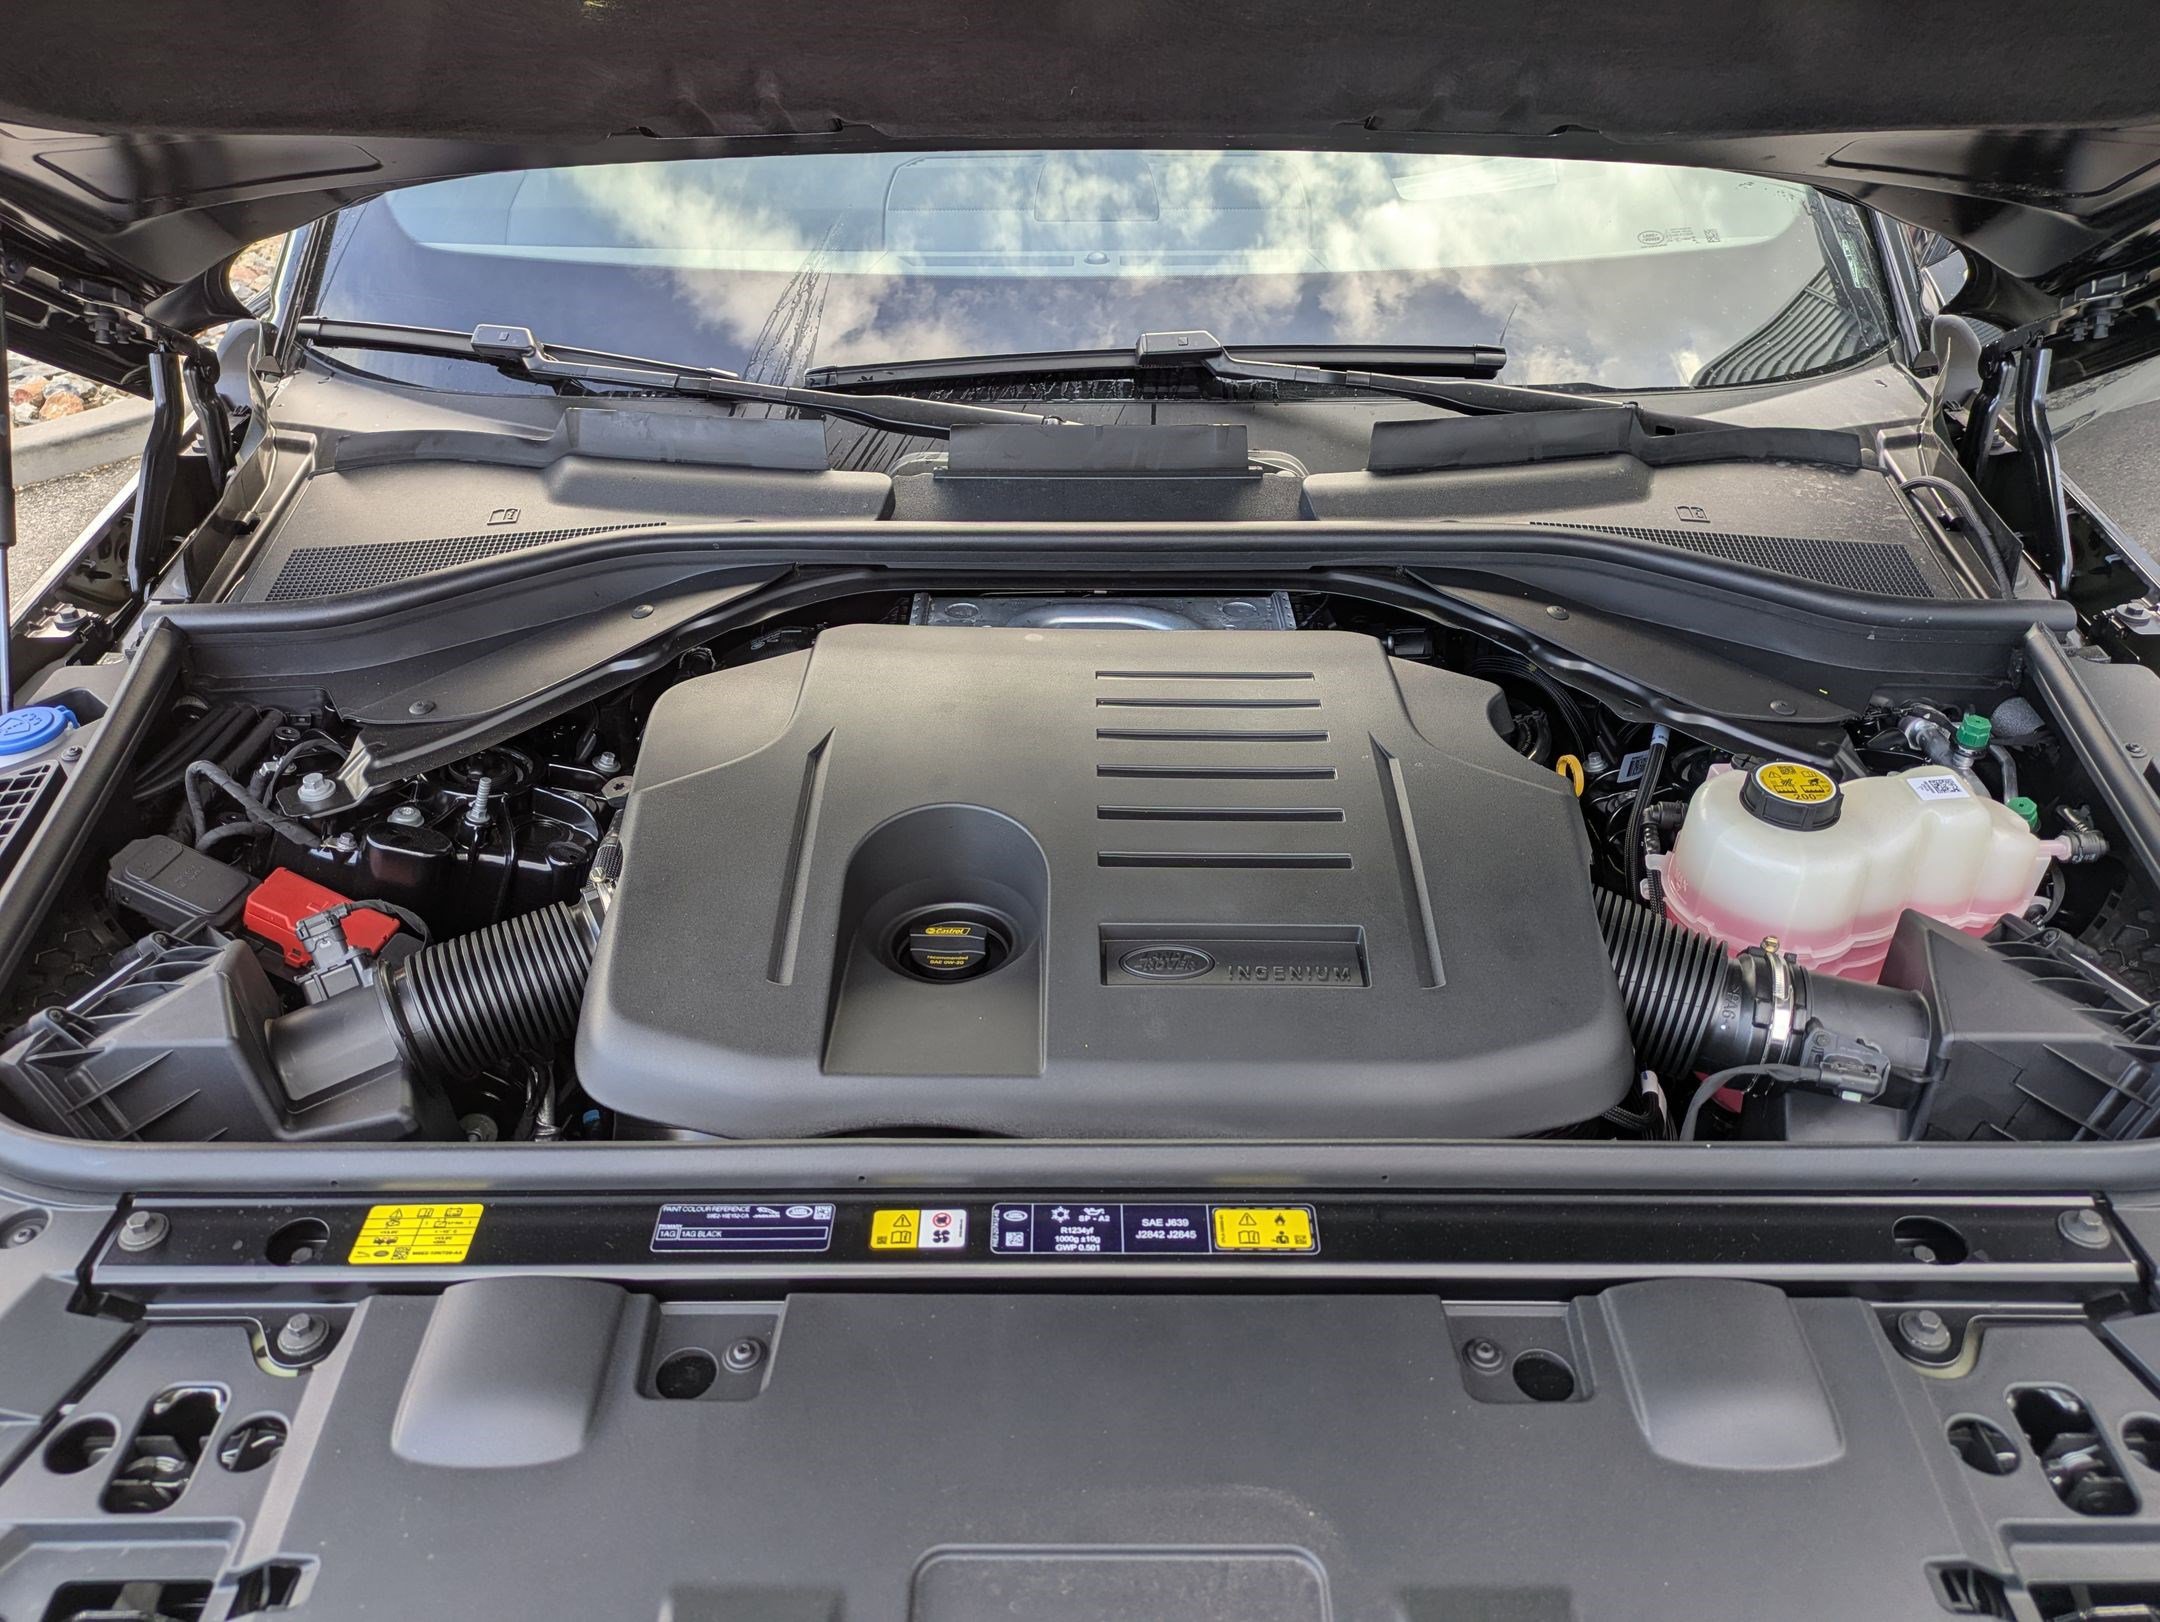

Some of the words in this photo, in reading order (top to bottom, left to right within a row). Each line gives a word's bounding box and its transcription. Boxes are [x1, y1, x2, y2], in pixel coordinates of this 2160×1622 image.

[935, 927, 964, 935] Castrol
[1228, 965, 1351, 982] INGENIUM
[1142, 1218, 1164, 1227] SAE
[1165, 1218, 1190, 1227] J639
[660, 1230, 676, 1238] 1AG
[682, 1230, 697, 1238] 1AG
[697, 1230, 722, 1238] BLACK
[1060, 1226, 1094, 1235] R1234yf
[1135, 1230, 1165, 1239] J2842
[1167, 1230, 1197, 1239] J2845
[1055, 1244, 1077, 1252] GWP
[1078, 1244, 1101, 1252] 0.501
